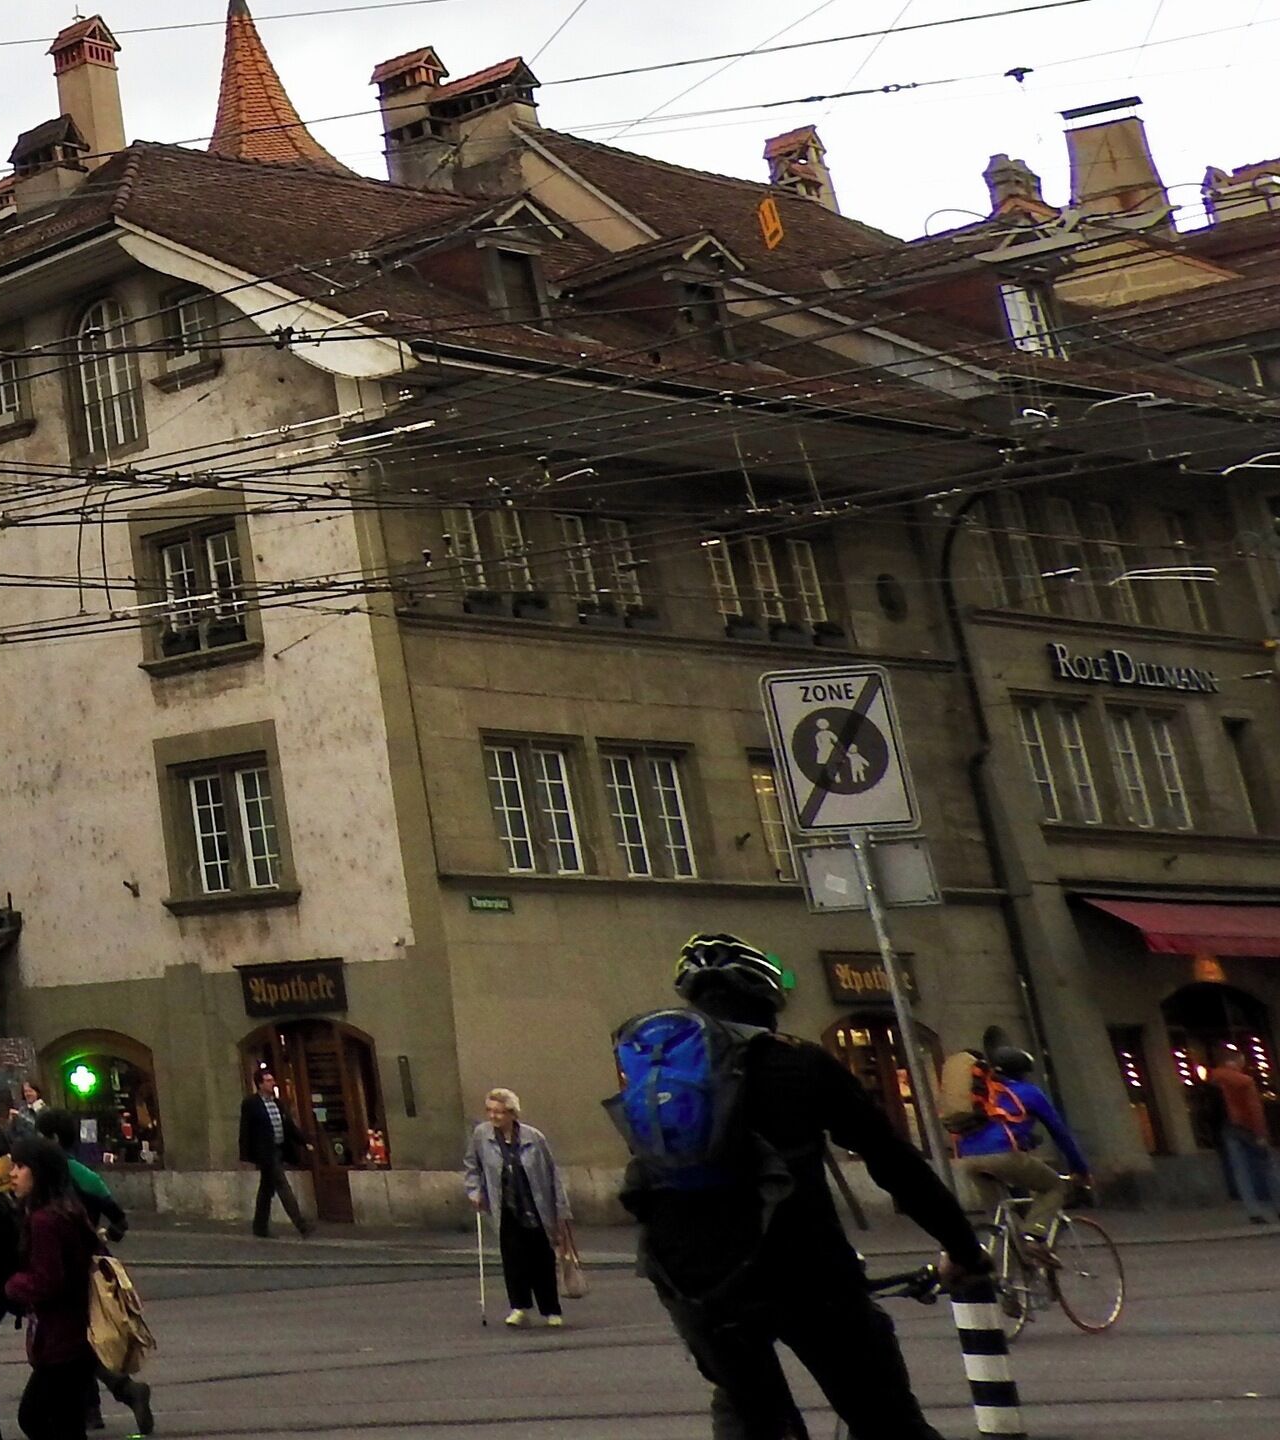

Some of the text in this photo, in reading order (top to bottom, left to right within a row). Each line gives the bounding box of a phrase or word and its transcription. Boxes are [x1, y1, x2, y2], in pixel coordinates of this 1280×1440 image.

[1053, 643, 1221, 693] ROLF DILLMANN
[799, 682, 855, 702] ZONE
[248, 973, 336, 1007] Apotheke
[832, 963, 913, 993] Apothe
